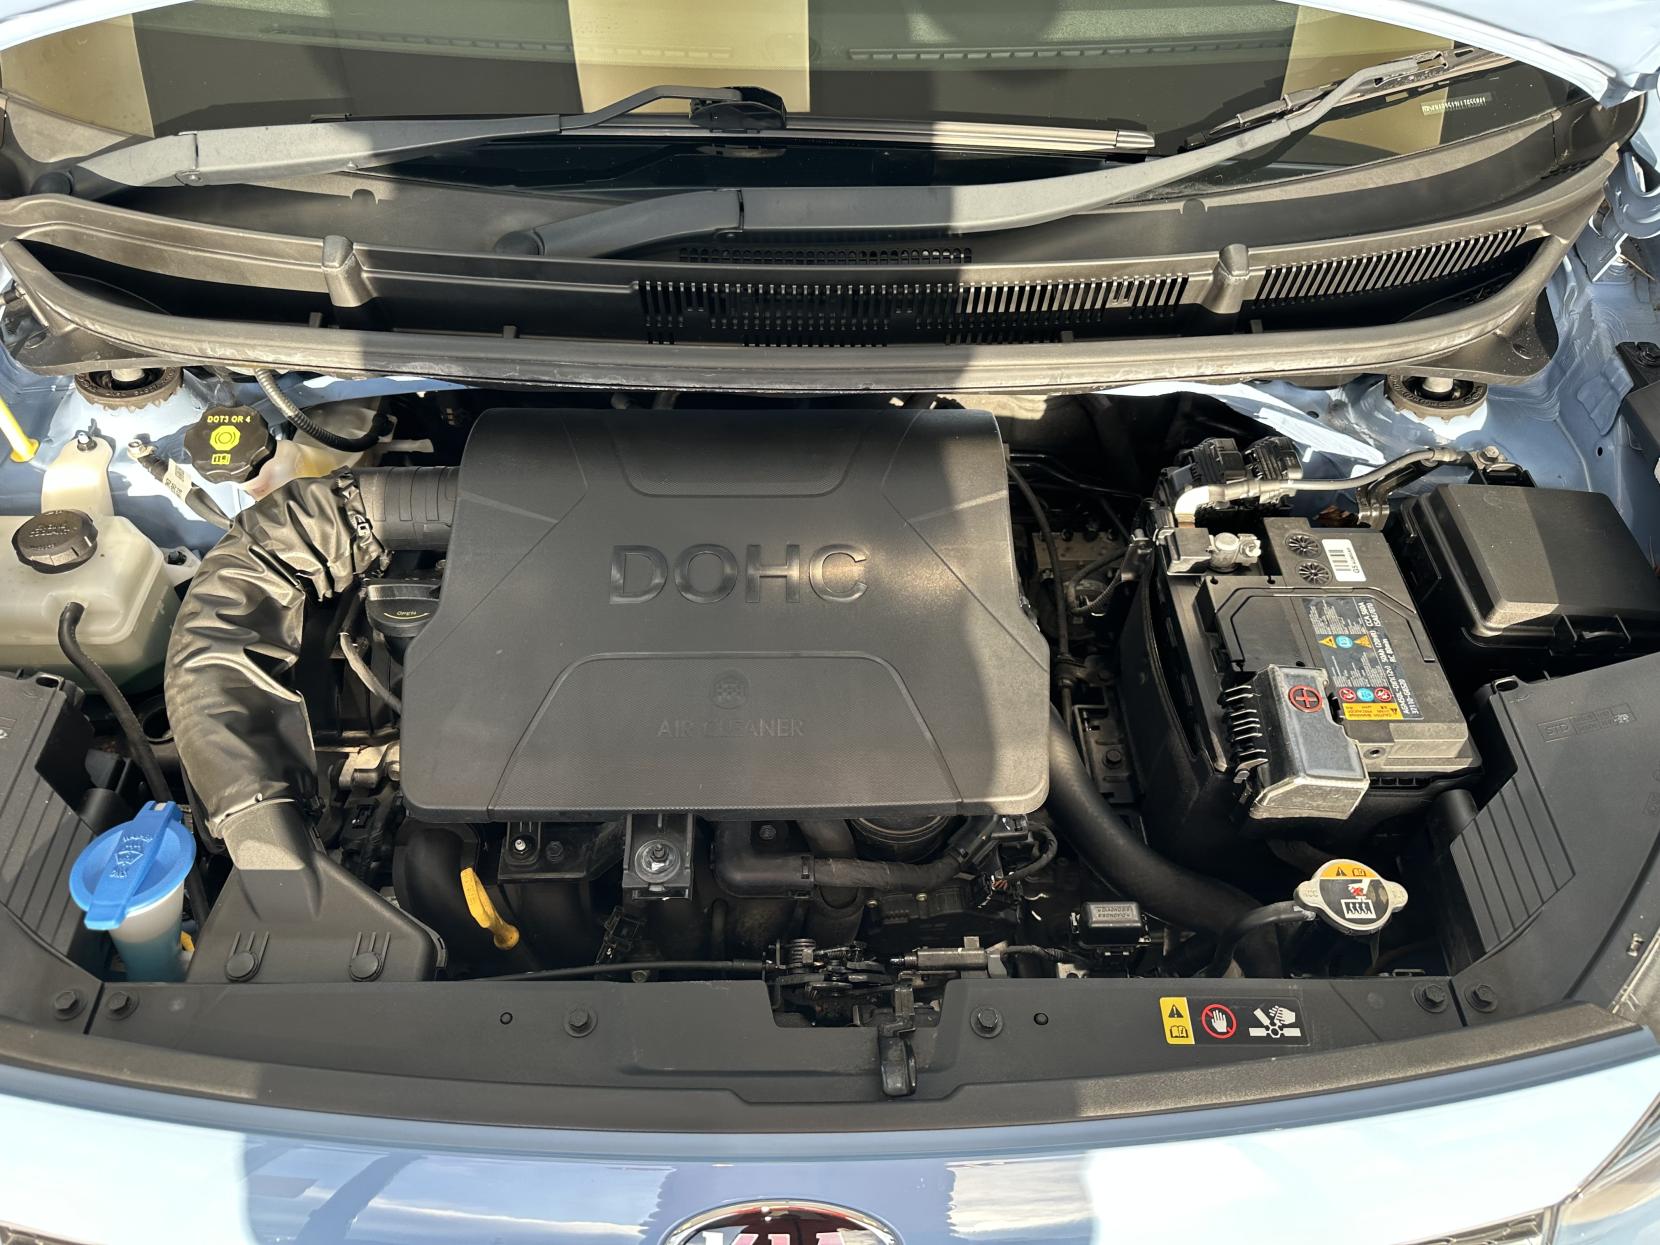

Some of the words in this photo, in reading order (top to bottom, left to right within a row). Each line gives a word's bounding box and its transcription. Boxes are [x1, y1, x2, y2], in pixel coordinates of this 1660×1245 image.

[207, 415, 228, 423] DOT3
[231, 415, 243, 423] OR
[245, 415, 251, 423] 4
[609, 543, 868, 604] DOHC
[1363, 615, 1373, 626] CCA
[656, 719, 696, 737] AIR
[703, 719, 805, 737] CLEANER
